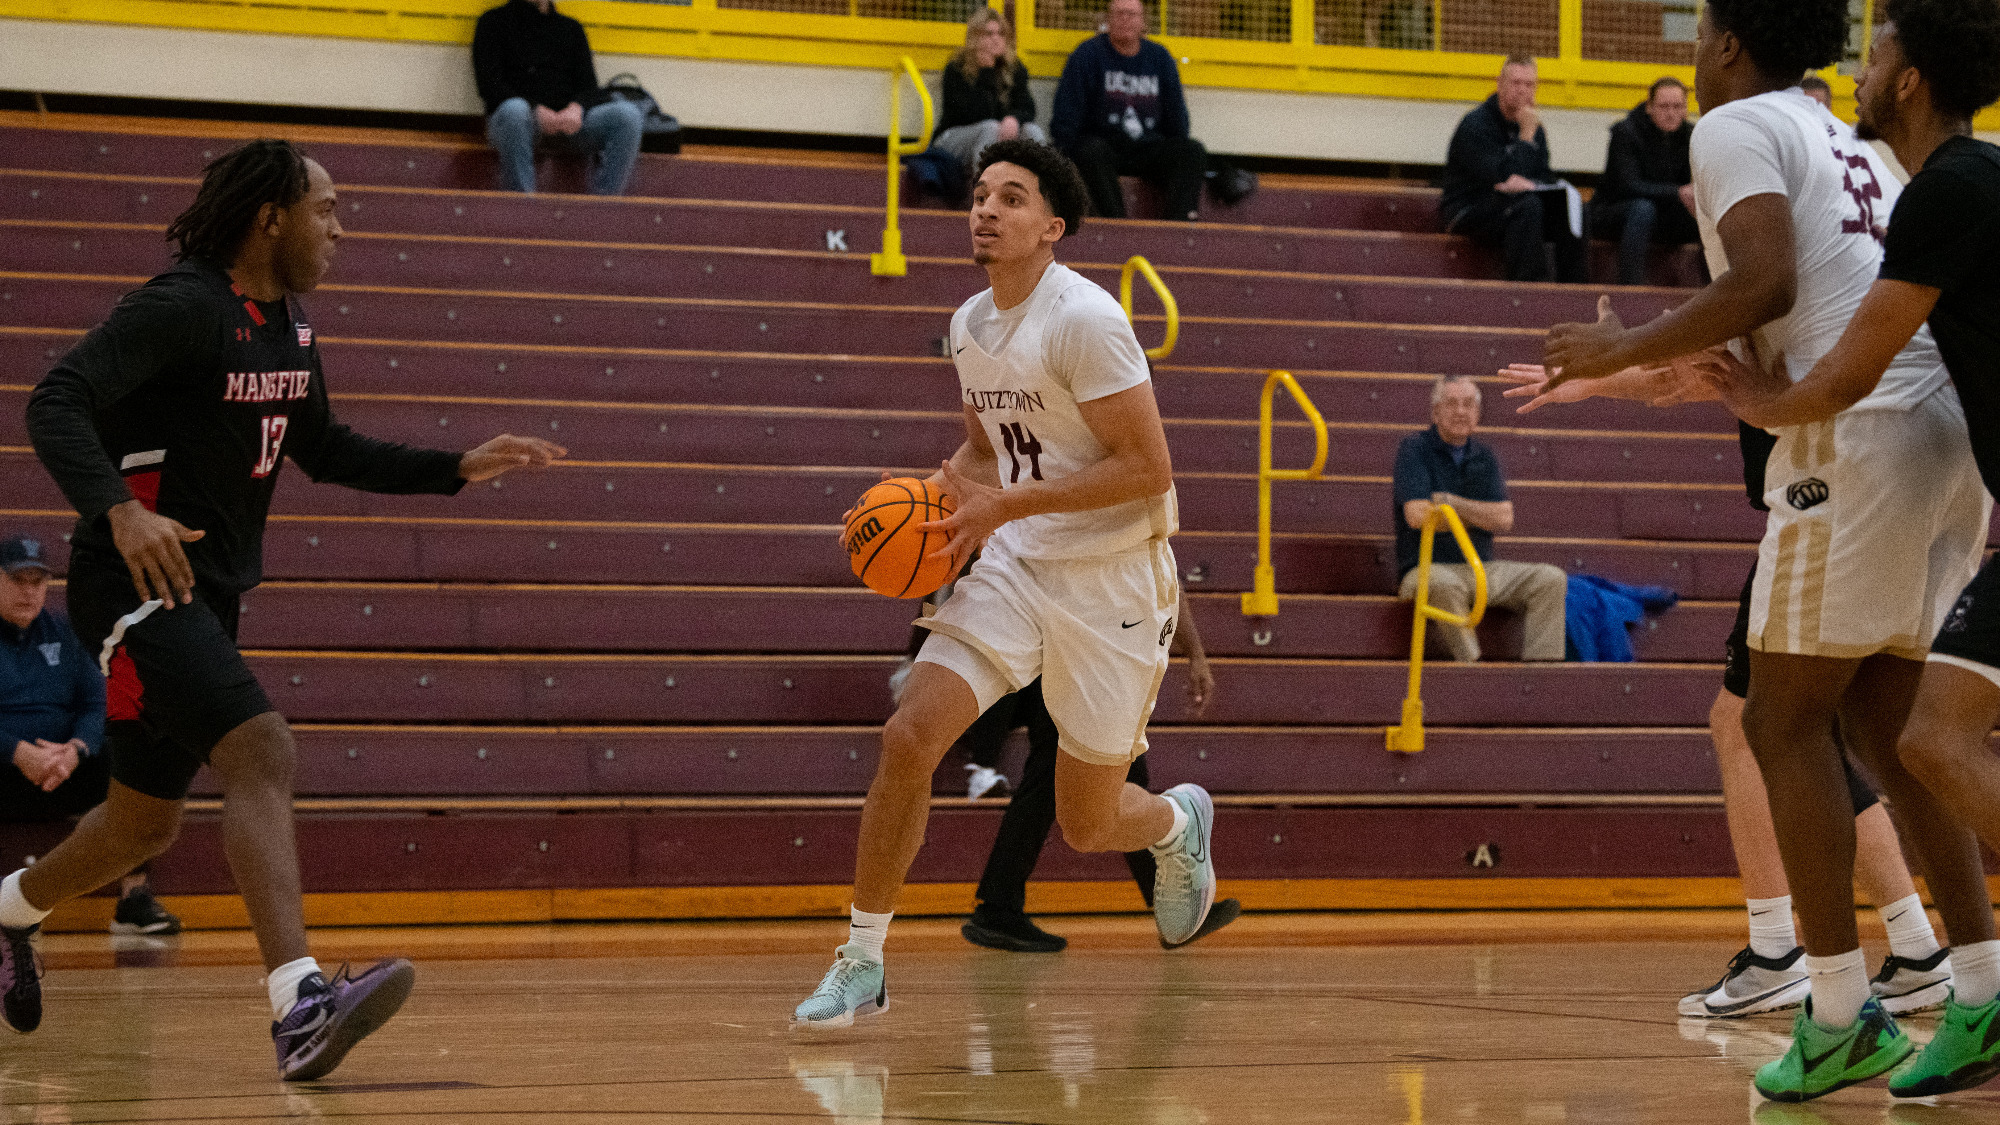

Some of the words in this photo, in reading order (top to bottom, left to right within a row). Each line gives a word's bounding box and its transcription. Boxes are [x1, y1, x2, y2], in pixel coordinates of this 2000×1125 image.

[1104, 71, 1159, 95] UCONN
[826, 229, 848, 251] K
[250, 415, 288, 479] 13
[999, 422, 1045, 483] 14
[1472, 843, 1494, 868] A
